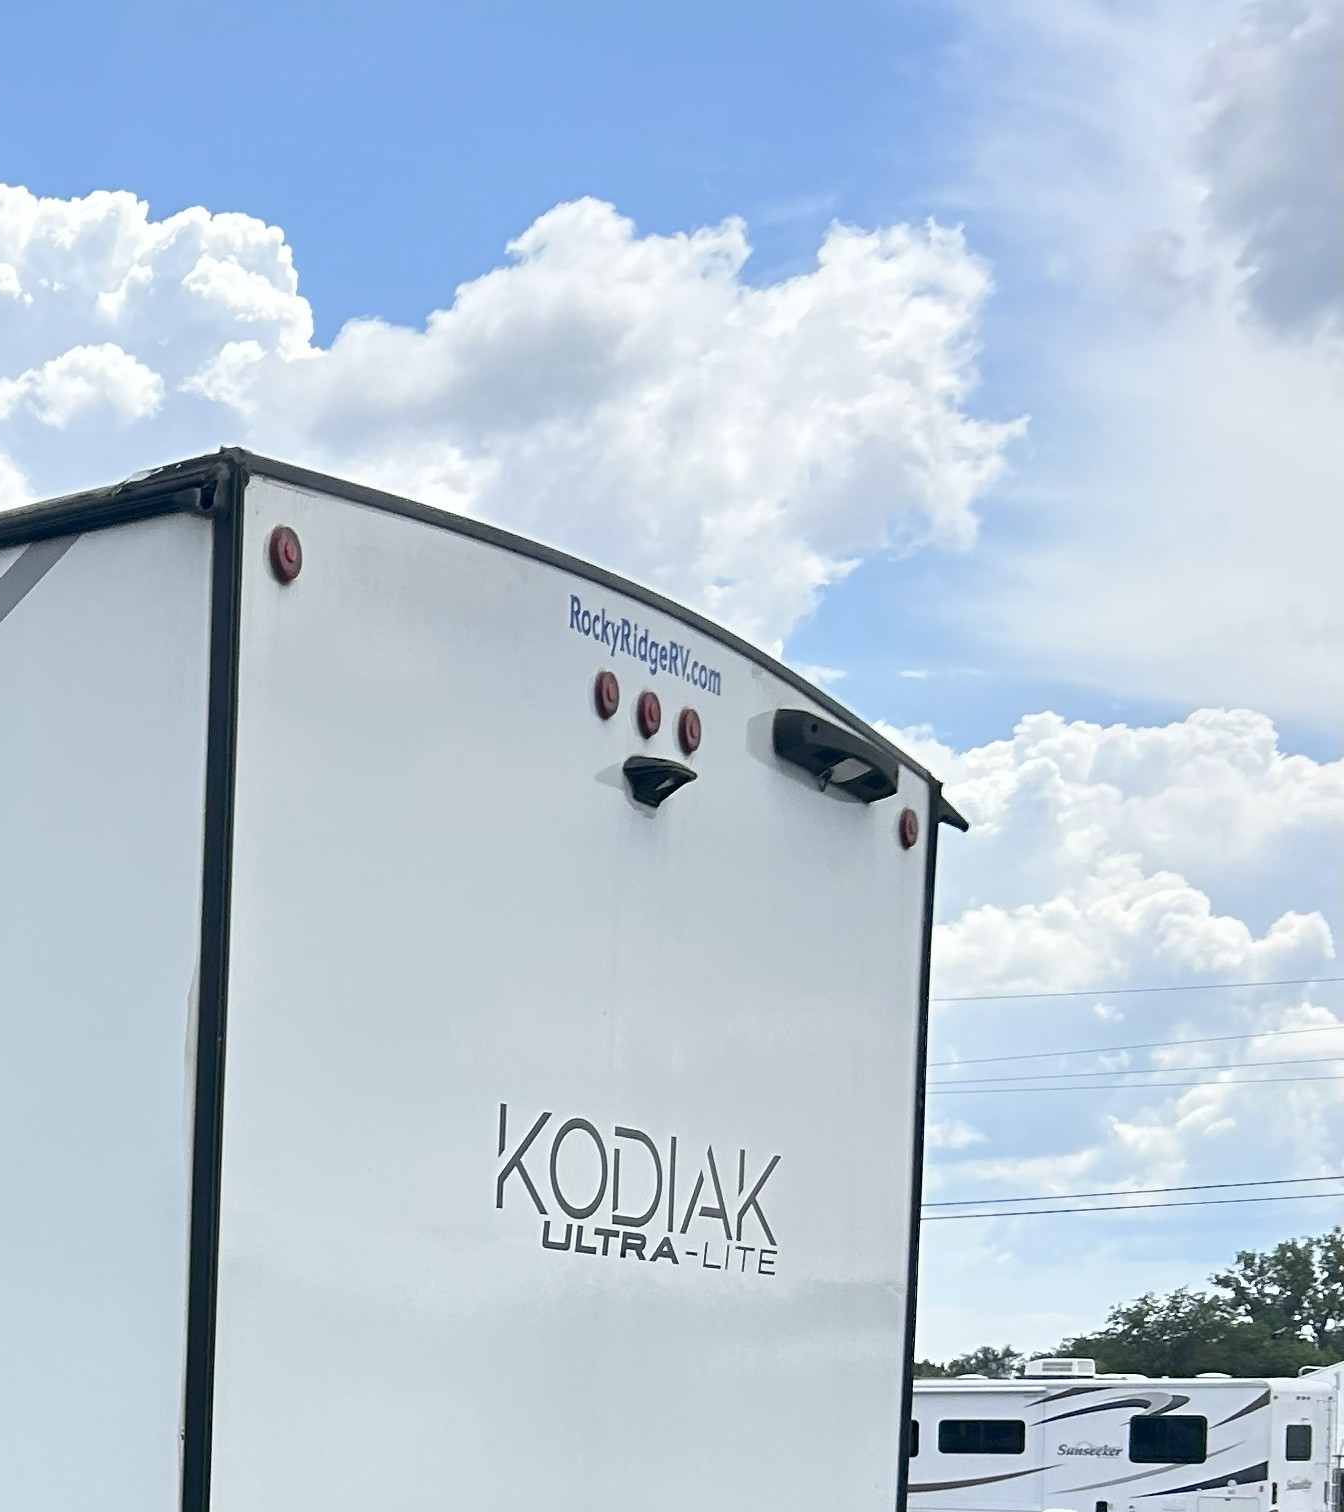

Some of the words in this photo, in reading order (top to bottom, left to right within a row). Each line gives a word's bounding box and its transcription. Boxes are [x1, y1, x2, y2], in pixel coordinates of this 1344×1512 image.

[569, 594, 721, 696] RockyRidgeRV.com
[496, 1103, 781, 1246] KODIAK
[542, 1220, 778, 1276] ULTRA-LITE
[1057, 1443, 1124, 1457] Sunseeker
